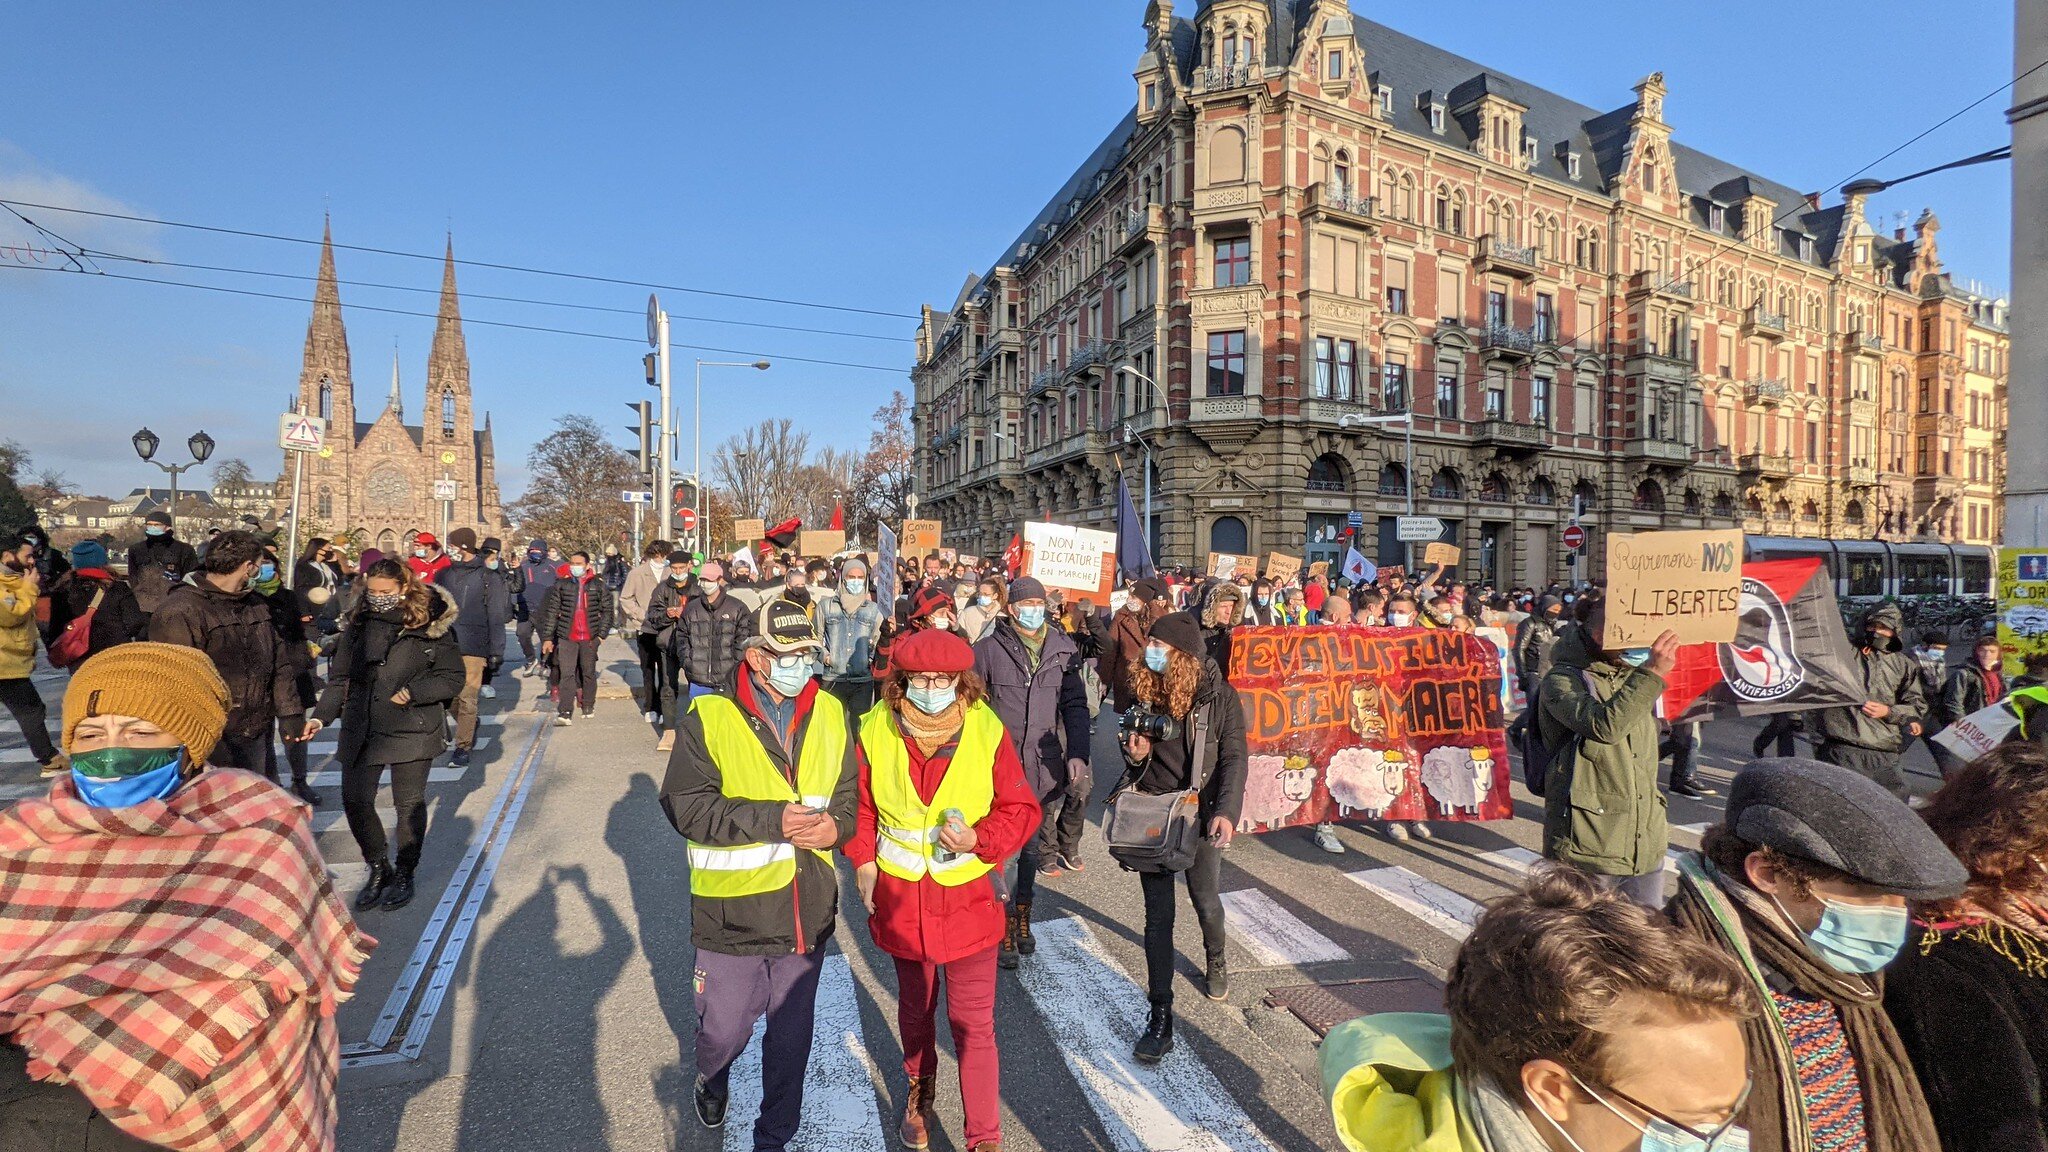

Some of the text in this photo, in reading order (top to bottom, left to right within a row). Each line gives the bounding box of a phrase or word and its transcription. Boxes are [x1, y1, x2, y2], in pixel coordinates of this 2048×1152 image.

[907, 523, 935, 532] COVID
[904, 534, 917, 545] 19
[1048, 536, 1074, 549] NON
[1089, 542, 1096, 552] la
[1040, 550, 1100, 568] DICTATURE
[1701, 540, 1734, 573] NOS
[1040, 567, 1053, 576] EN
[1741, 582, 1758, 594] ION
[1631, 587, 1739, 616] LIBERTES
